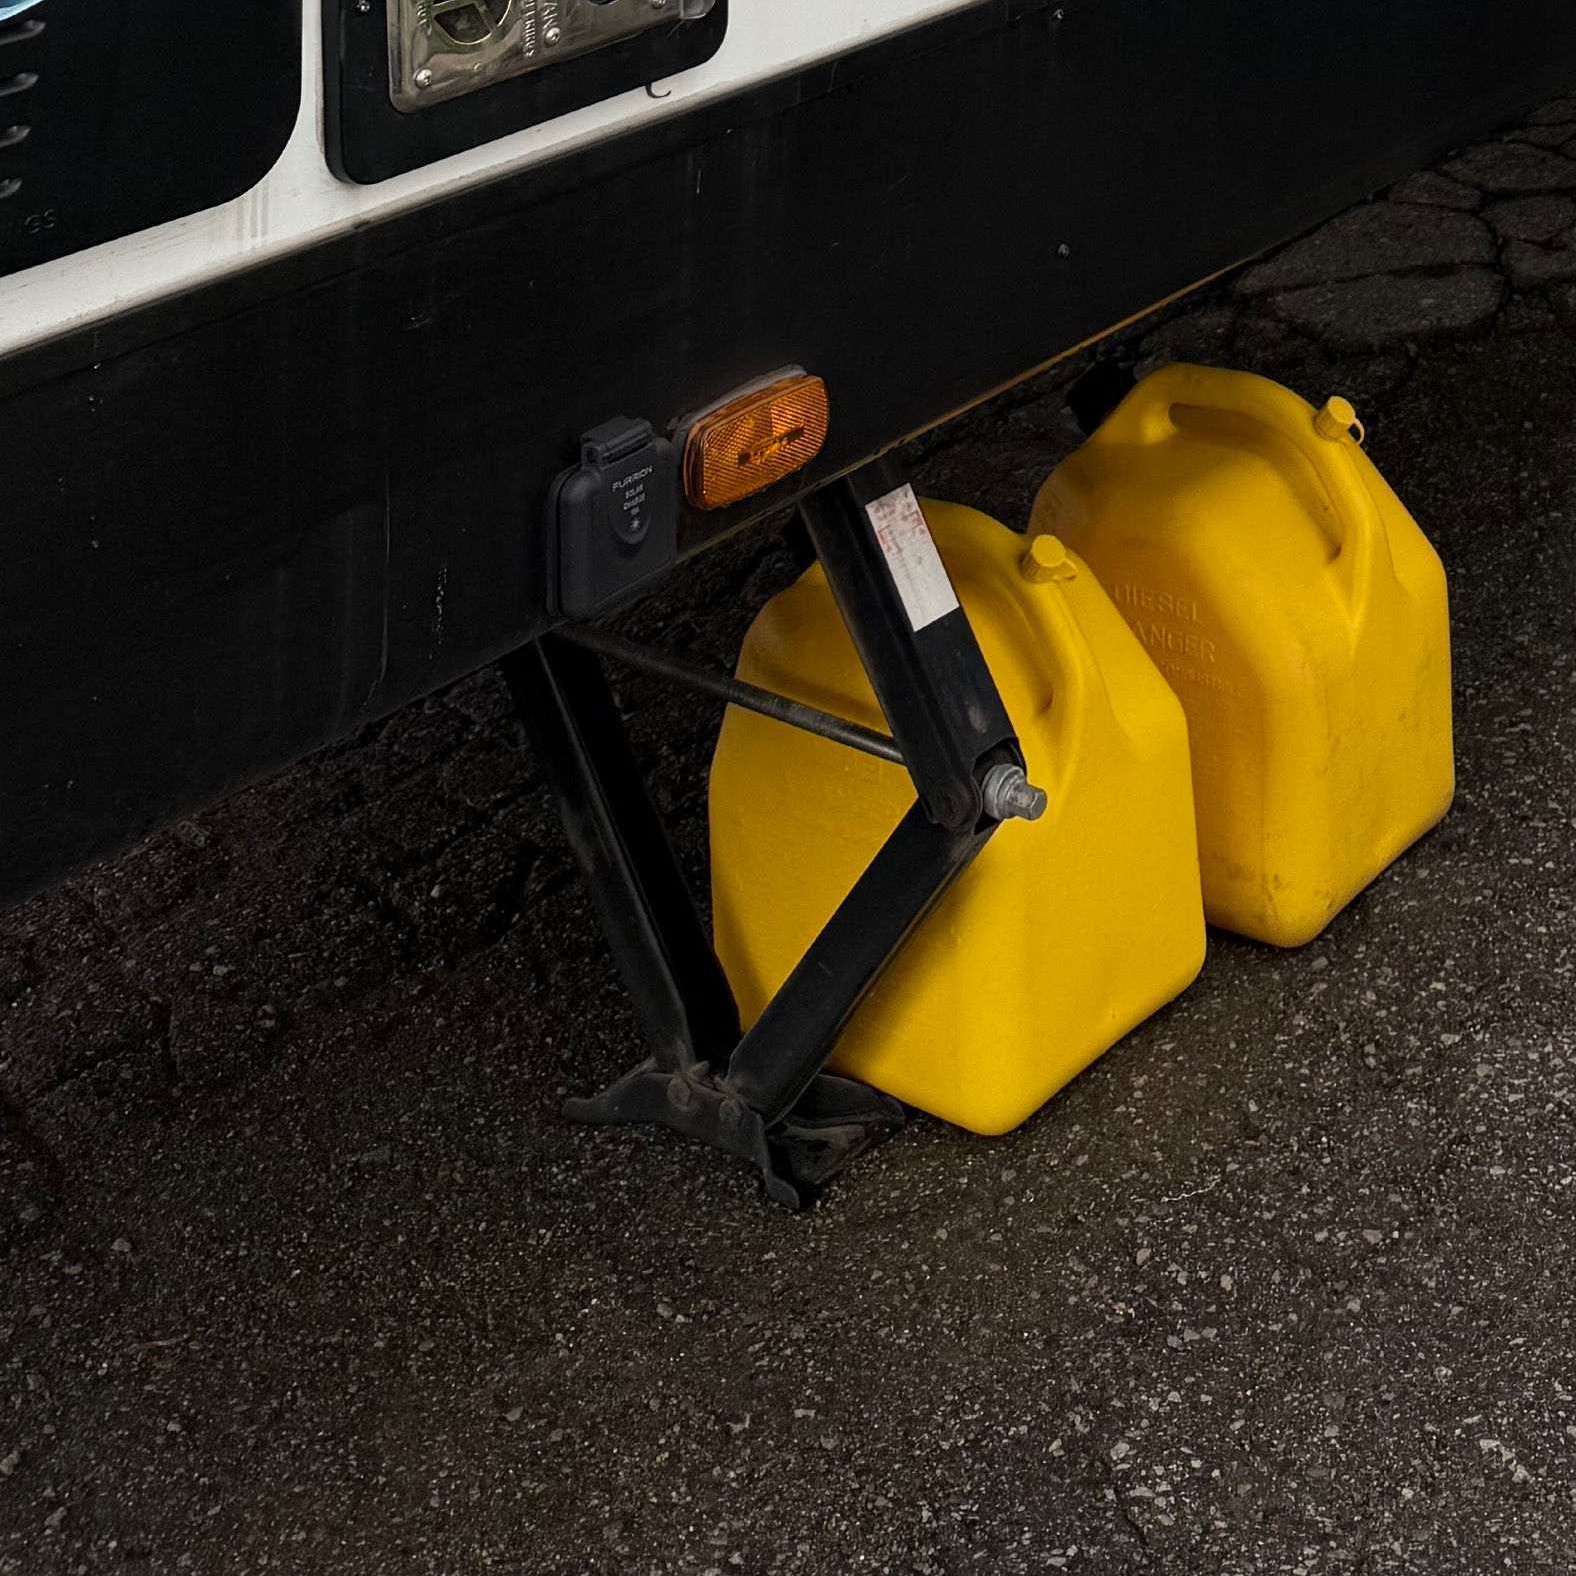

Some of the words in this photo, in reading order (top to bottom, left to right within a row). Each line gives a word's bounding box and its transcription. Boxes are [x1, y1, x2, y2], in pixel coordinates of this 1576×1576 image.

[612, 465, 653, 493] FURRION
[1112, 582, 1205, 625] DIESEL
[1131, 620, 1217, 664] ANGER
